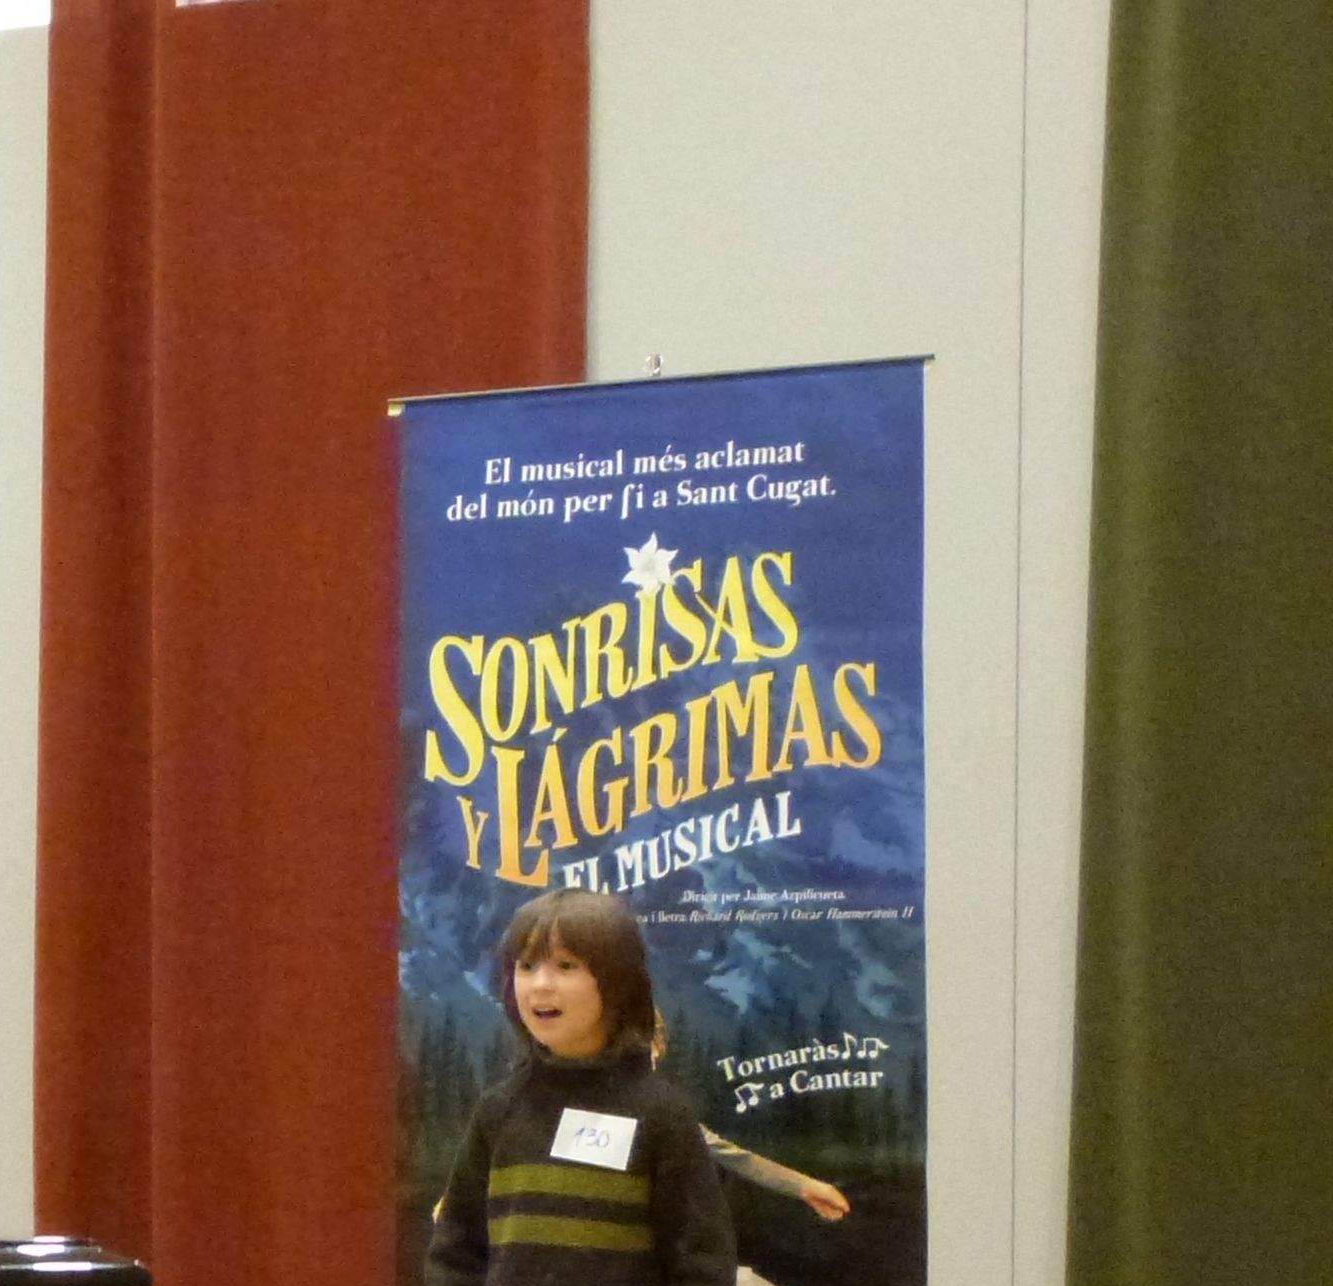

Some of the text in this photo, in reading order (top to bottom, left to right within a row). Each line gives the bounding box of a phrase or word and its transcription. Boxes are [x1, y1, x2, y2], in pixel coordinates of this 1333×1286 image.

[485, 440, 805, 484] El musical més aclamat
[447, 474, 836, 522] del món per fi a Sant Cugat.
[424, 551, 799, 786] SONRISAS
[456, 661, 882, 887] Y LÁGRIMAS
[614, 791, 802, 892] MUSICAL
[716, 1038, 840, 1082] Tornaràs
[769, 1069, 883, 1099] a Cantar
